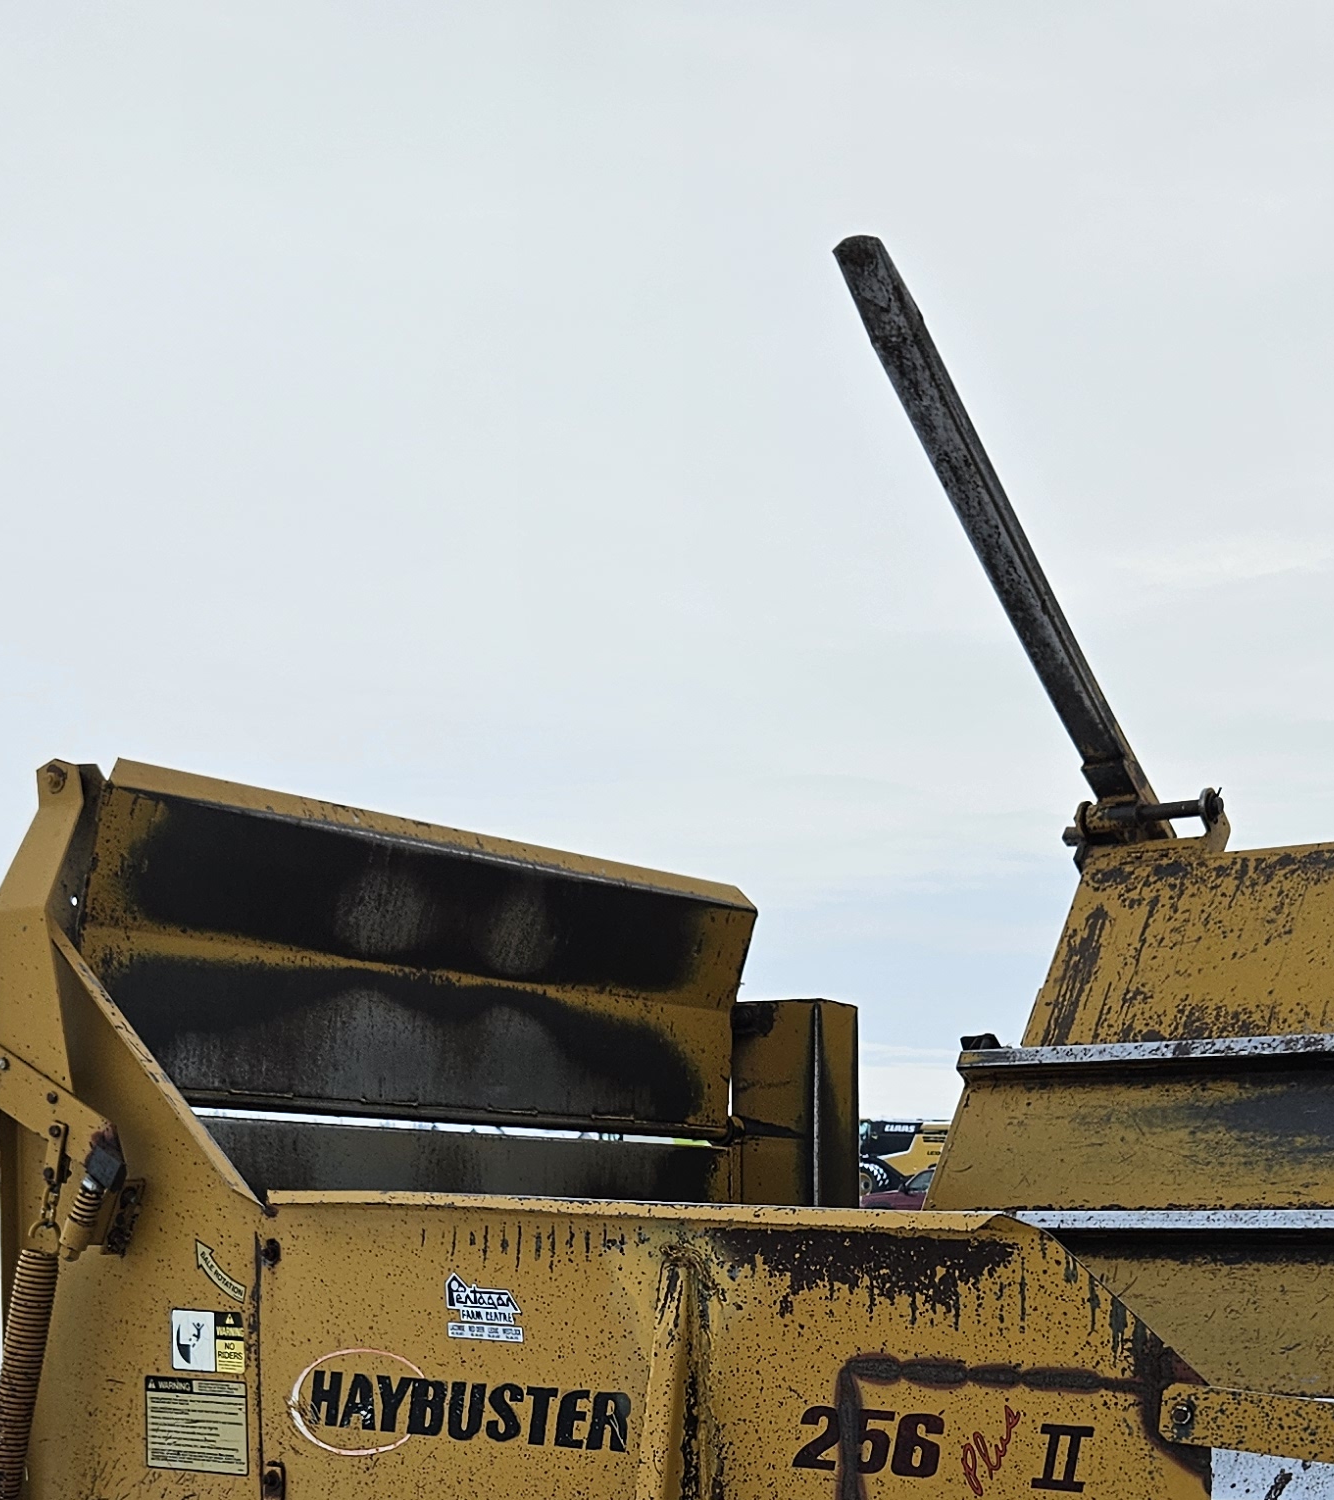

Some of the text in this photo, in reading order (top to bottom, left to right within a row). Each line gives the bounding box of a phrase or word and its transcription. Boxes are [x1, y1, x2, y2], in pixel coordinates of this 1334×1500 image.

[884, 1124, 915, 1133] CLAAS
[200, 1250, 244, 1297] BALE ROTATION
[448, 1275, 519, 1311] Pentagon
[462, 1309, 513, 1322] FARM CENTRE
[216, 1326, 244, 1337] WARNING
[224, 1342, 235, 1350] NO
[218, 1351, 243, 1361] RIDERS
[158, 1380, 191, 1392] WARNING
[309, 1370, 631, 1453] HAYBUSTER
[792, 1404, 1095, 1497] 256 Plus II
